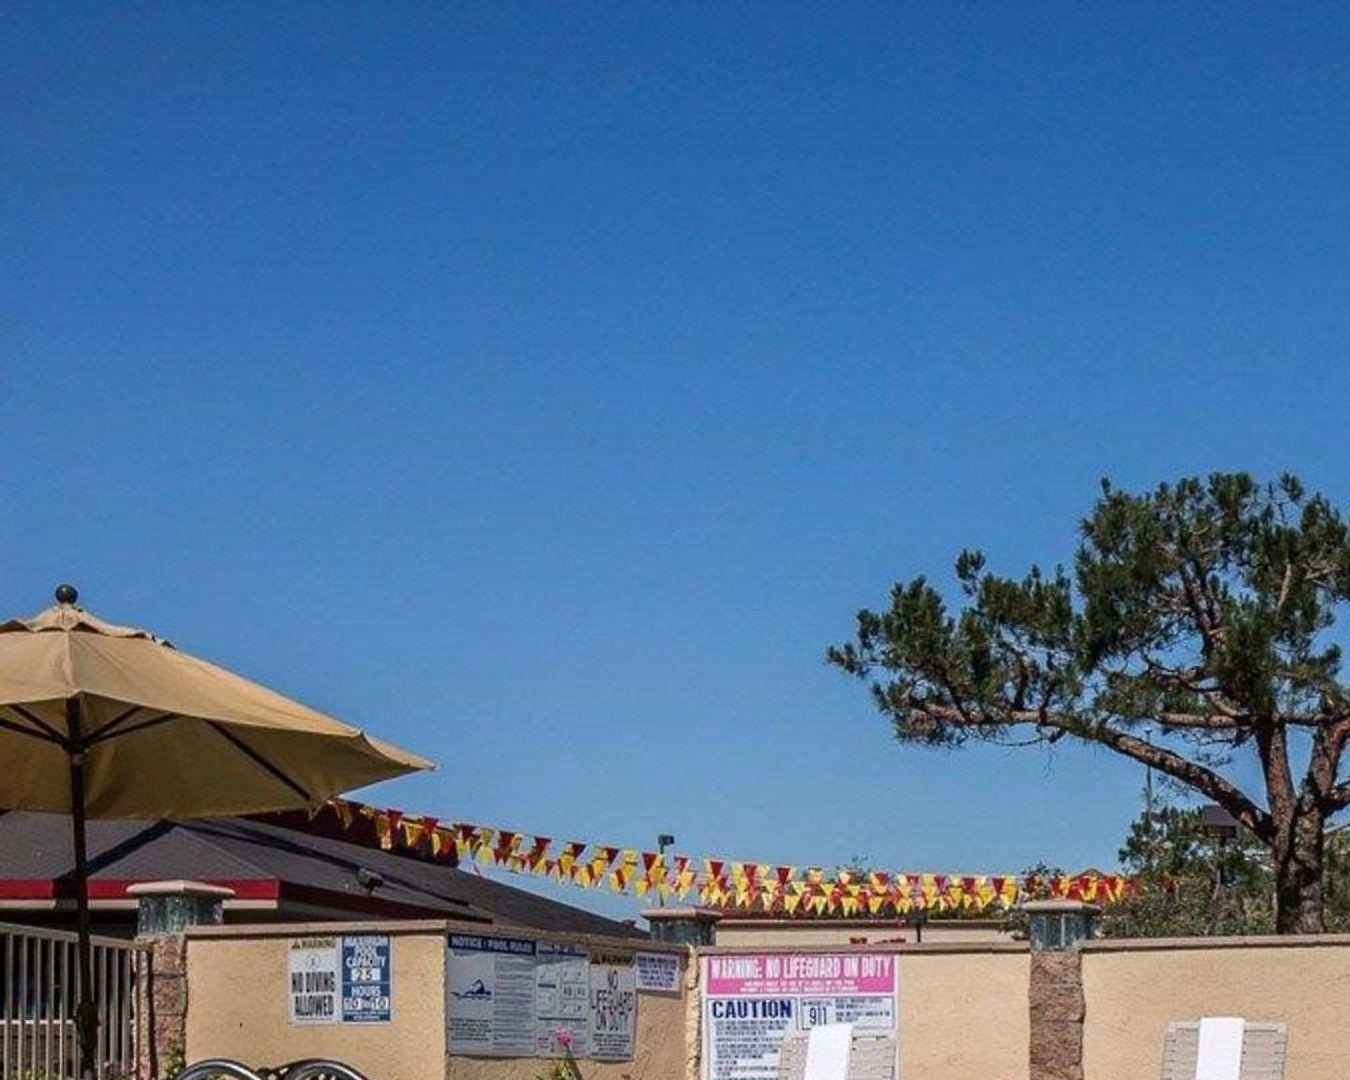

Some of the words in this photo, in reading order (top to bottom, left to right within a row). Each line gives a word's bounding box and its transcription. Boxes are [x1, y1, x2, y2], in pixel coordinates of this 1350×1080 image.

[452, 936, 481, 949] NOTICE
[357, 969, 373, 980] 25
[711, 957, 763, 979] WARNING:
[766, 956, 781, 978] NO
[784, 956, 841, 978] LIFEGUARD
[843, 956, 859, 978] ON
[861, 956, 891, 978] DUTY
[291, 971, 303, 993] NO
[305, 971, 335, 993] DIVING
[607, 969, 618, 990] NO
[351, 985, 381, 997] HOURS
[295, 994, 335, 1016] ALLOWED
[712, 1000, 792, 1018] CAUTION
[809, 1007, 827, 1025] 911
